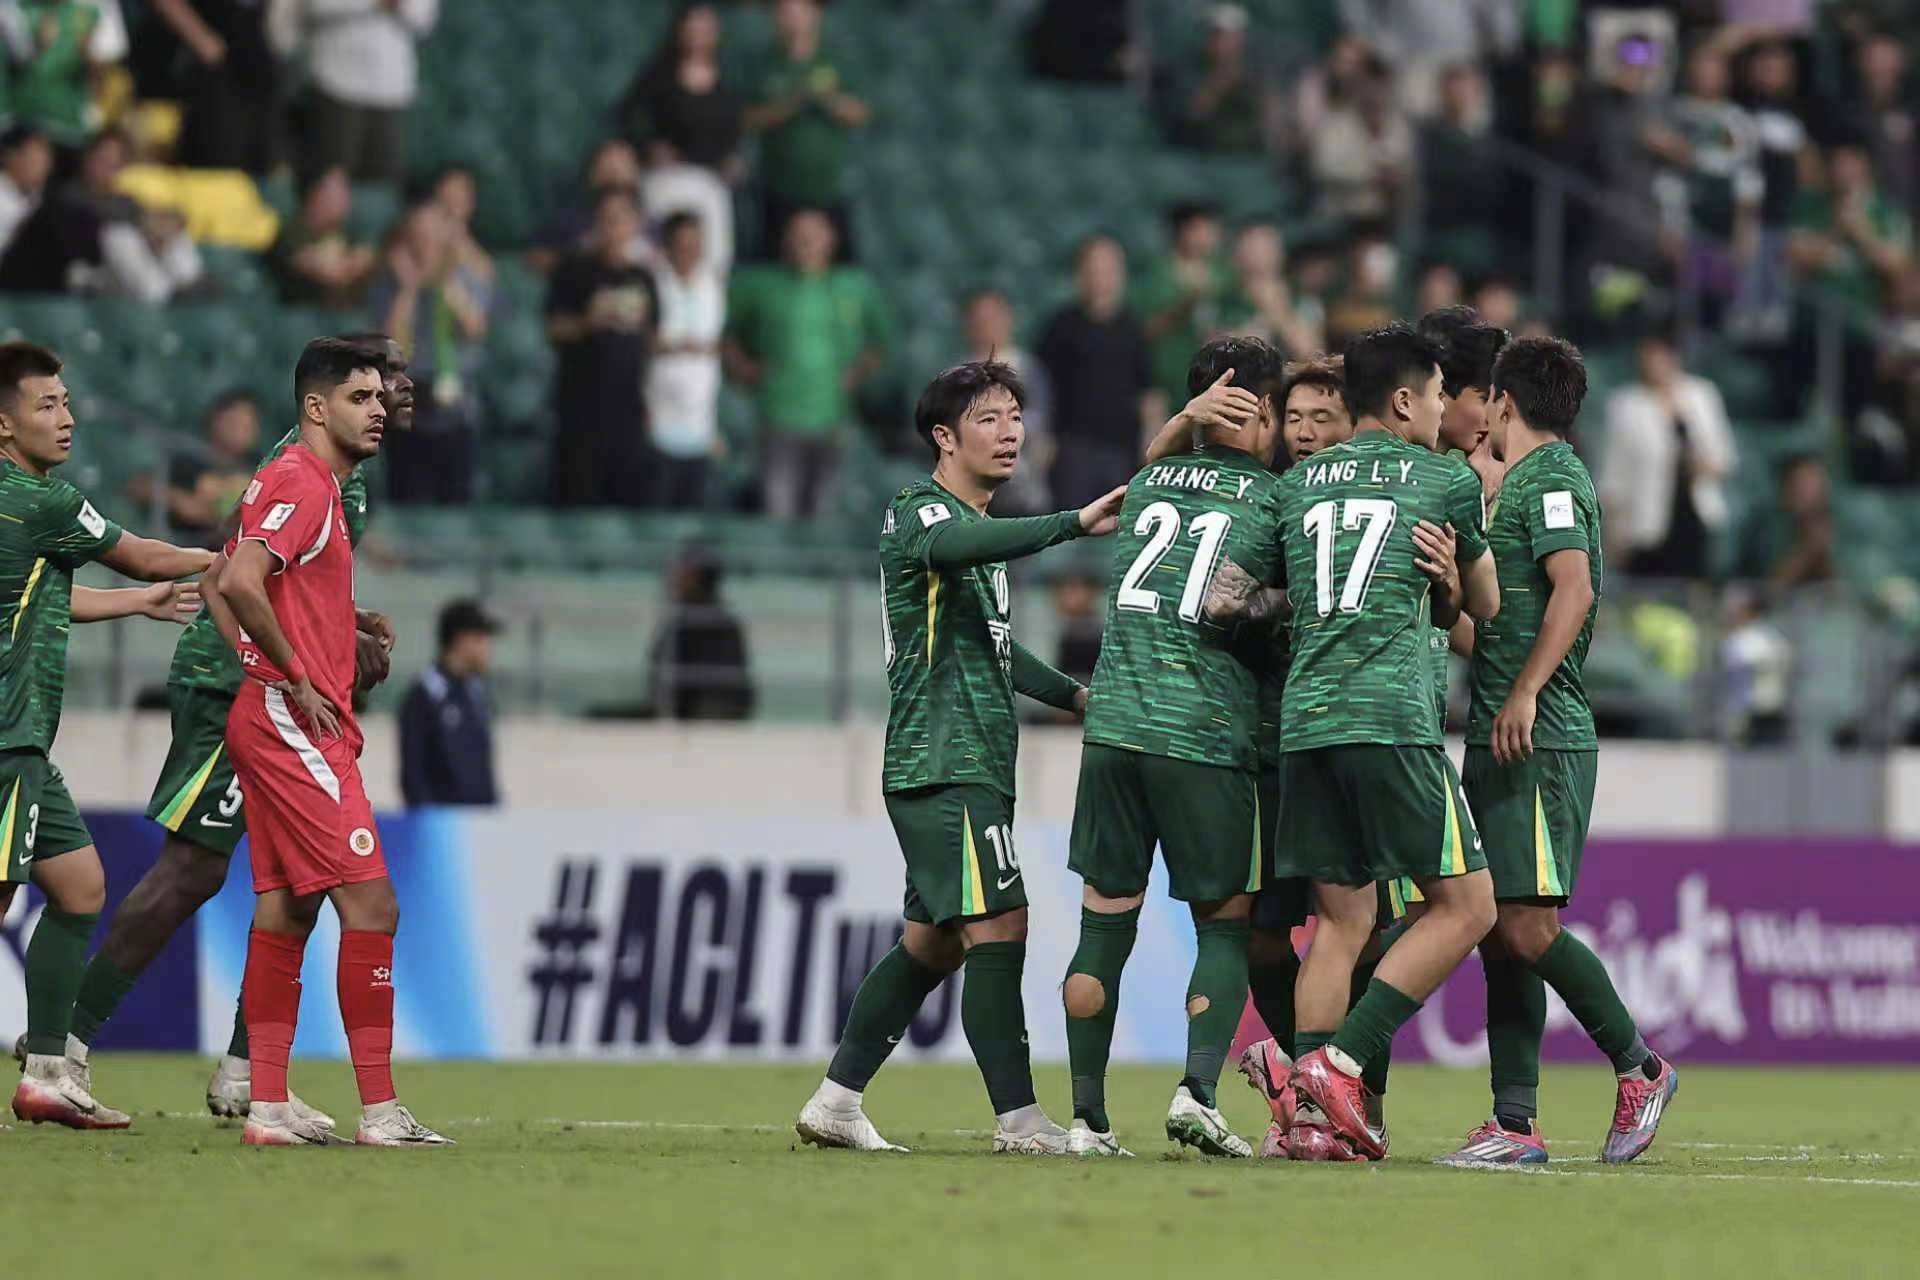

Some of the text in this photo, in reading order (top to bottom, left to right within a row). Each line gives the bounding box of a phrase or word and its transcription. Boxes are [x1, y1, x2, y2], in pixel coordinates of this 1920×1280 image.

[1145, 466, 1255, 503] ZHANG Y.
[1304, 459, 1418, 487] YANG L. Y.
[1116, 500, 1232, 624] 21
[1303, 499, 1397, 618] 17
[219, 773, 243, 817] 5
[25, 803, 39, 849] 3
